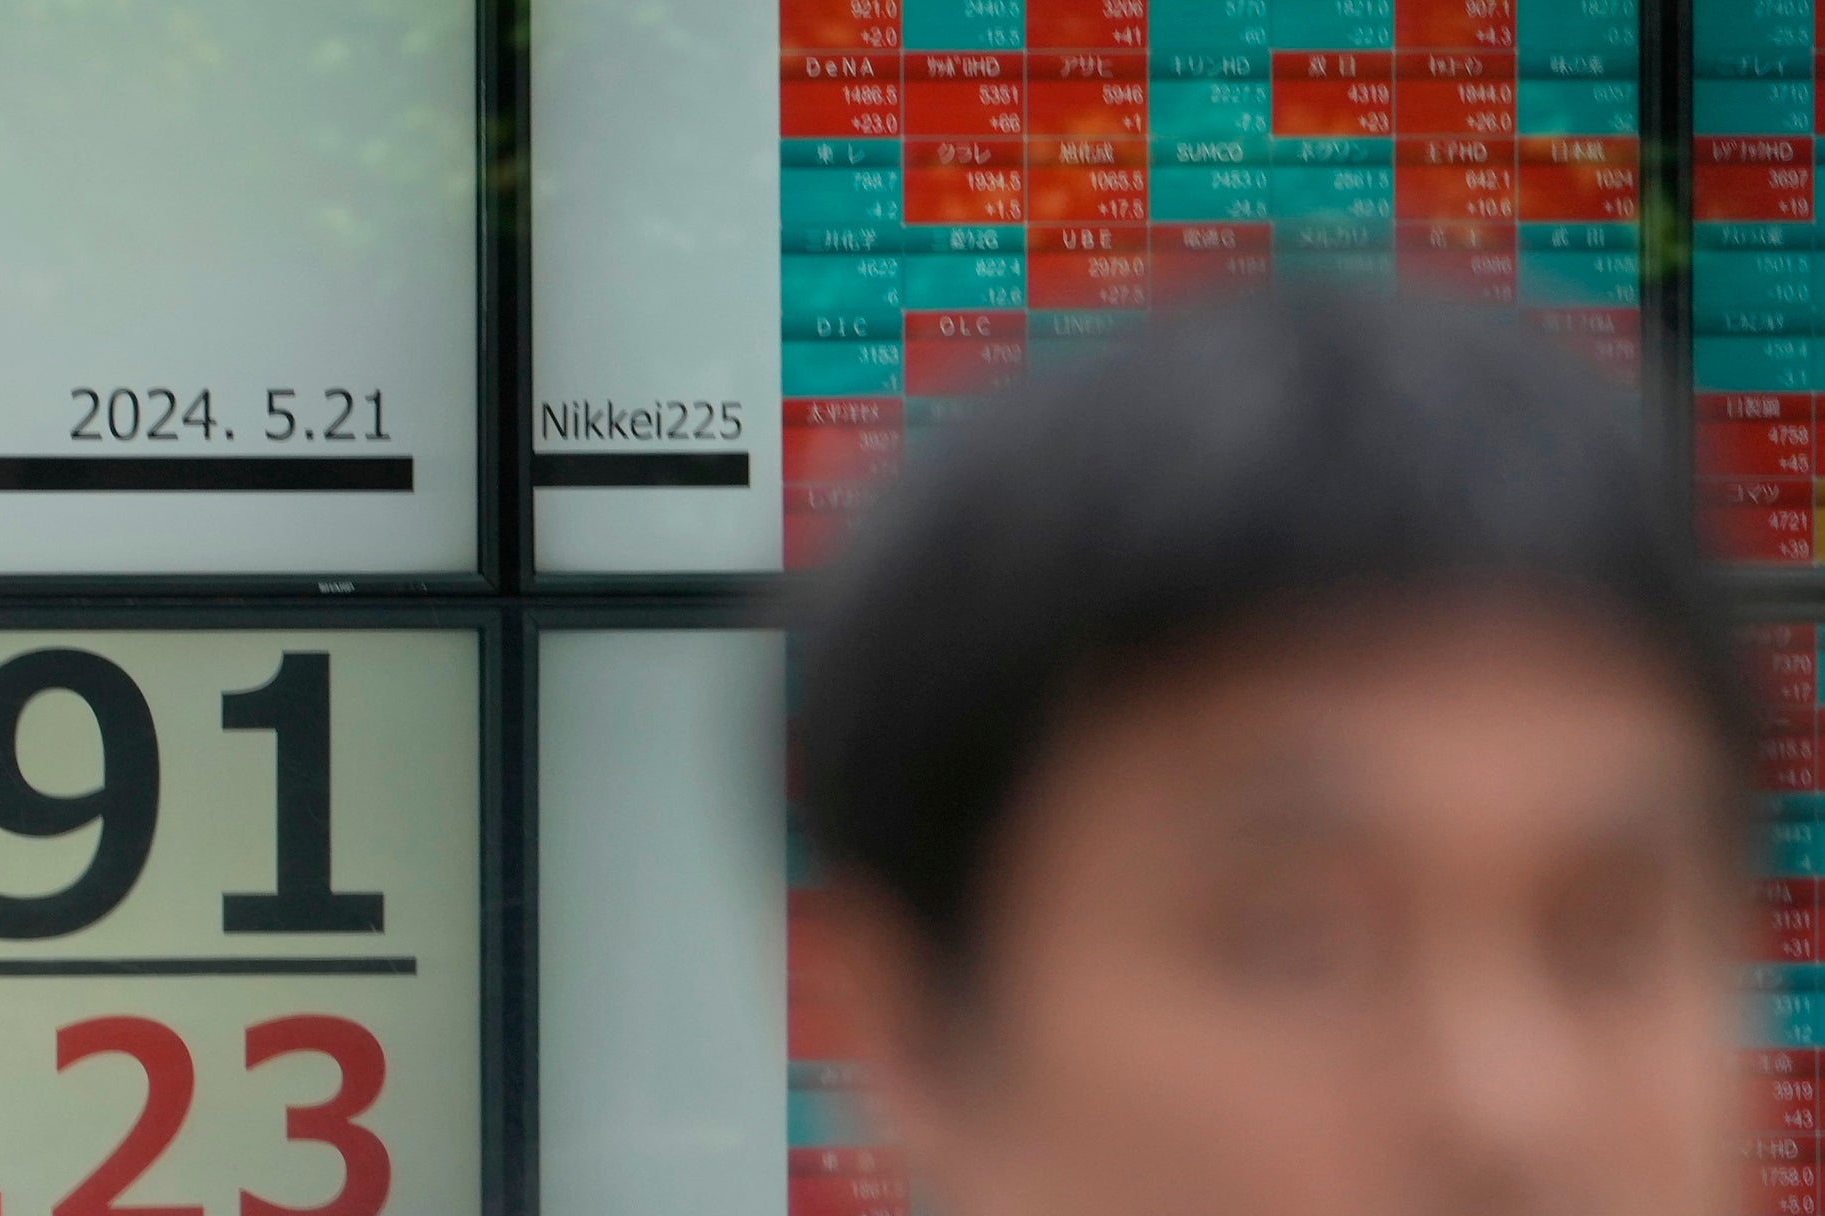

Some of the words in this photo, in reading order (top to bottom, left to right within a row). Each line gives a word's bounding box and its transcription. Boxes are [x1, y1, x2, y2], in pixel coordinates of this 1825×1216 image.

[806, 57, 874, 78] DeNA
[1176, 142, 1244, 163] SUMCO
[1062, 228, 1112, 250] UBE
[817, 317, 868, 337] DIC
[940, 316, 991, 337] OLC
[70, 388, 234, 441] 2024.
[265, 388, 391, 441] 5.21
[541, 400, 743, 441] Nikkei225
